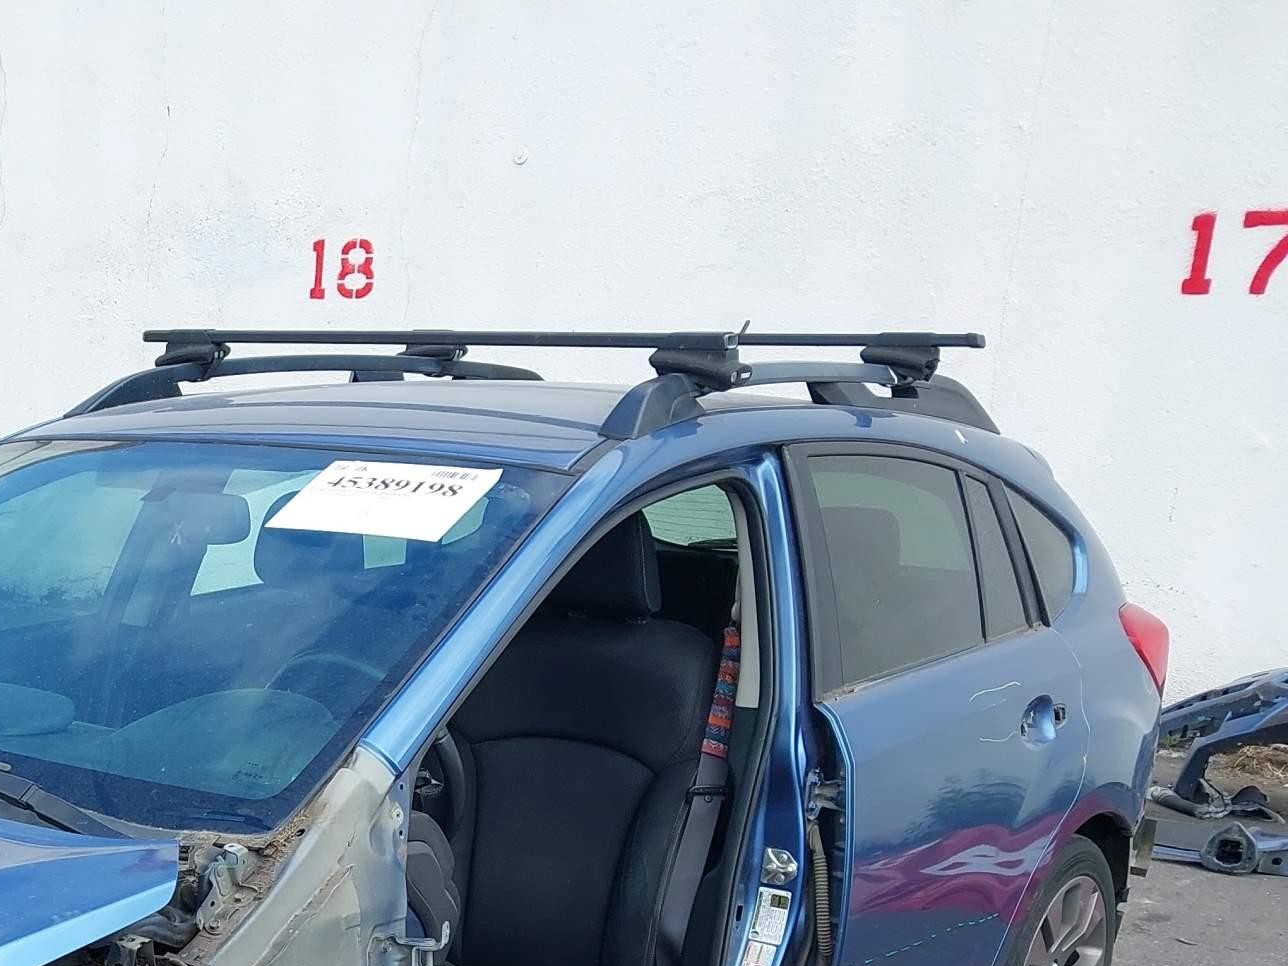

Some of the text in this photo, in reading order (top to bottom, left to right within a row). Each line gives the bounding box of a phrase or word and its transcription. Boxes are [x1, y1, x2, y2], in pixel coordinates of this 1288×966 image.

[309, 238, 375, 300] 18
[1180, 209, 1288, 296] 17
[327, 475, 464, 498] 45389198
